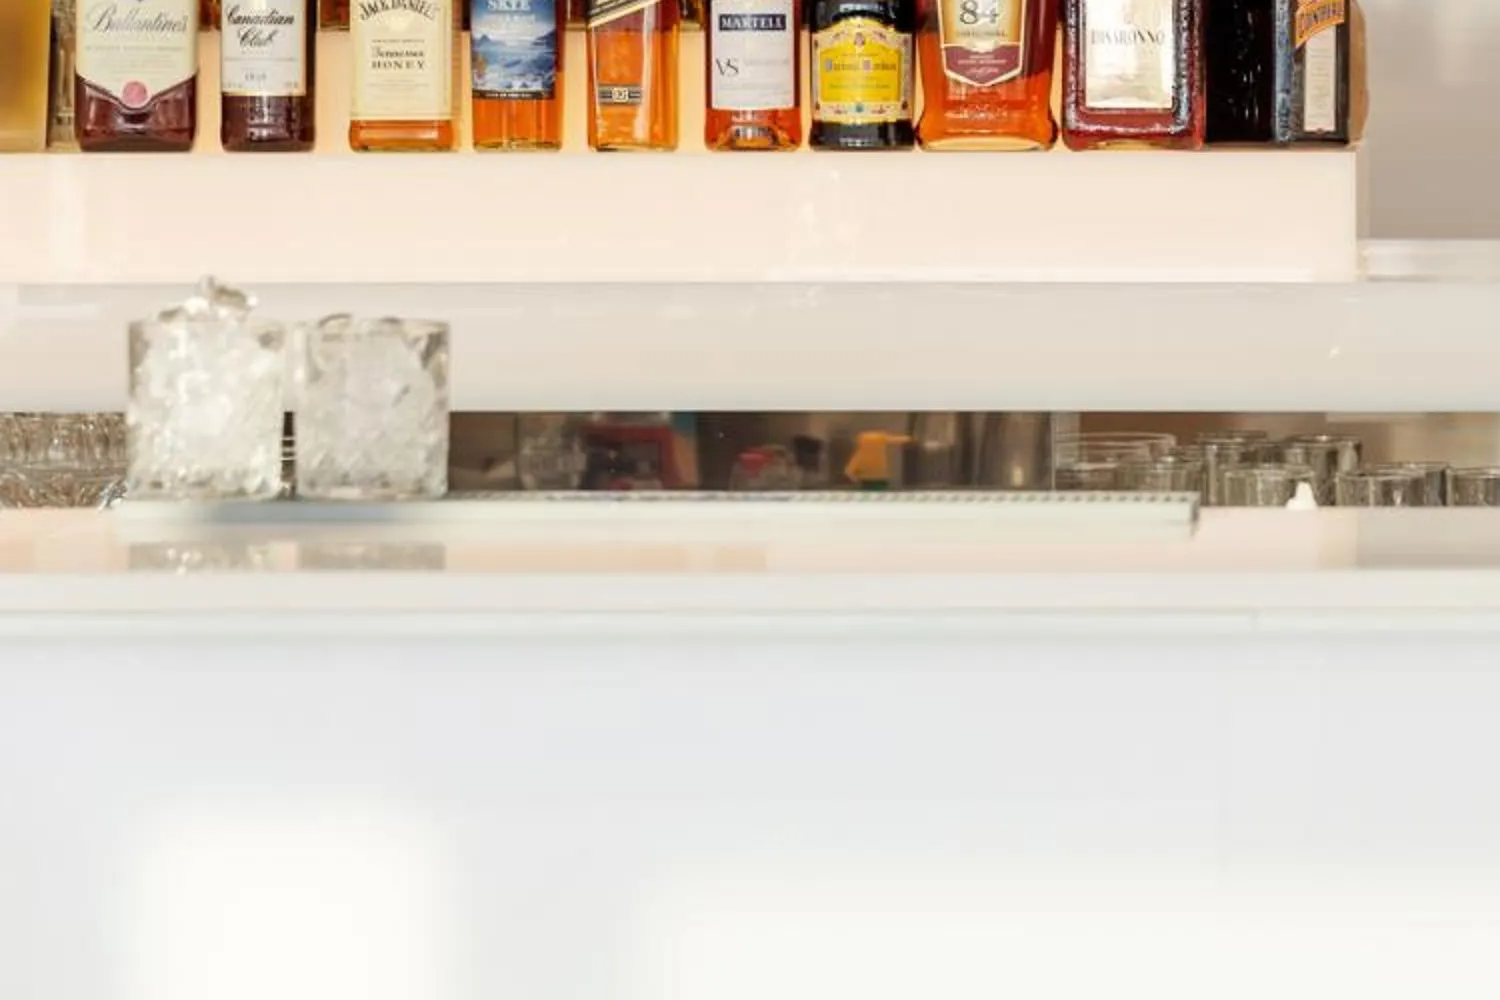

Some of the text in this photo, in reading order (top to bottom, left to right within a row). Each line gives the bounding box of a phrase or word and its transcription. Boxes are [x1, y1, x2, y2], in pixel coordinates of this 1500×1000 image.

[226, 4, 296, 25] Canadian
[959, 0, 1000, 25] 84
[721, 16, 783, 29] MARTELL
[237, 26, 279, 47] Club
[371, 60, 426, 70] HONEY
[715, 58, 740, 76] VS
